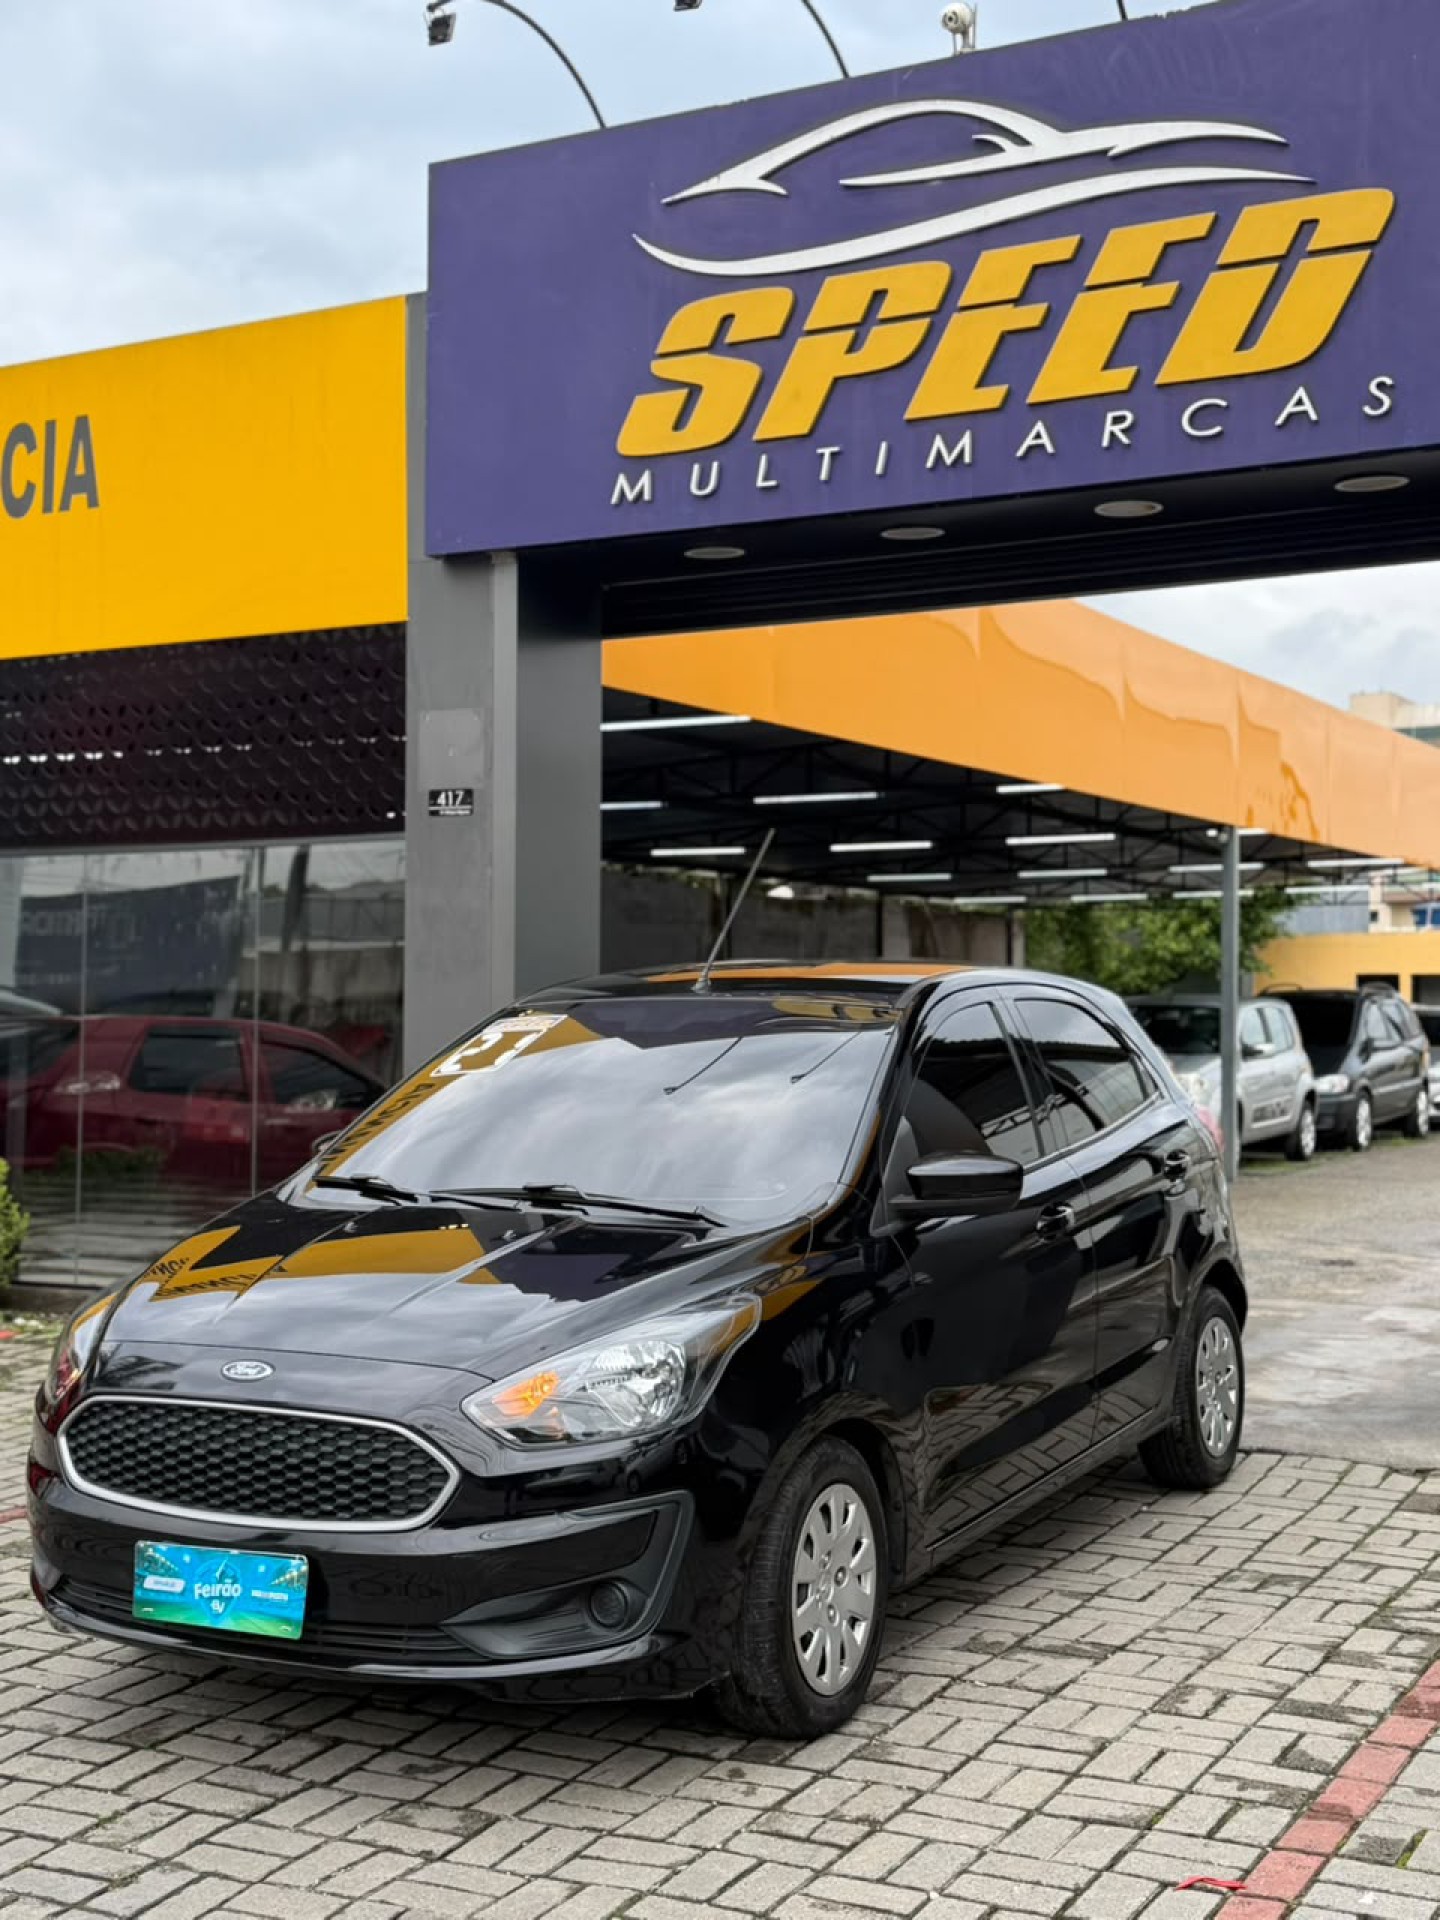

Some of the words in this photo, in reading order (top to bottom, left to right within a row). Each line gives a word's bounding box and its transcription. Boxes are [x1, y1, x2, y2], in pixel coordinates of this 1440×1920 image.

[617, 189, 1396, 458] SPEED
[0, 413, 100, 520] CIA
[610, 375, 1394, 506] MULTIMARCAS
[437, 790, 464, 806] 417
[194, 1578, 242, 1600] Feirão
